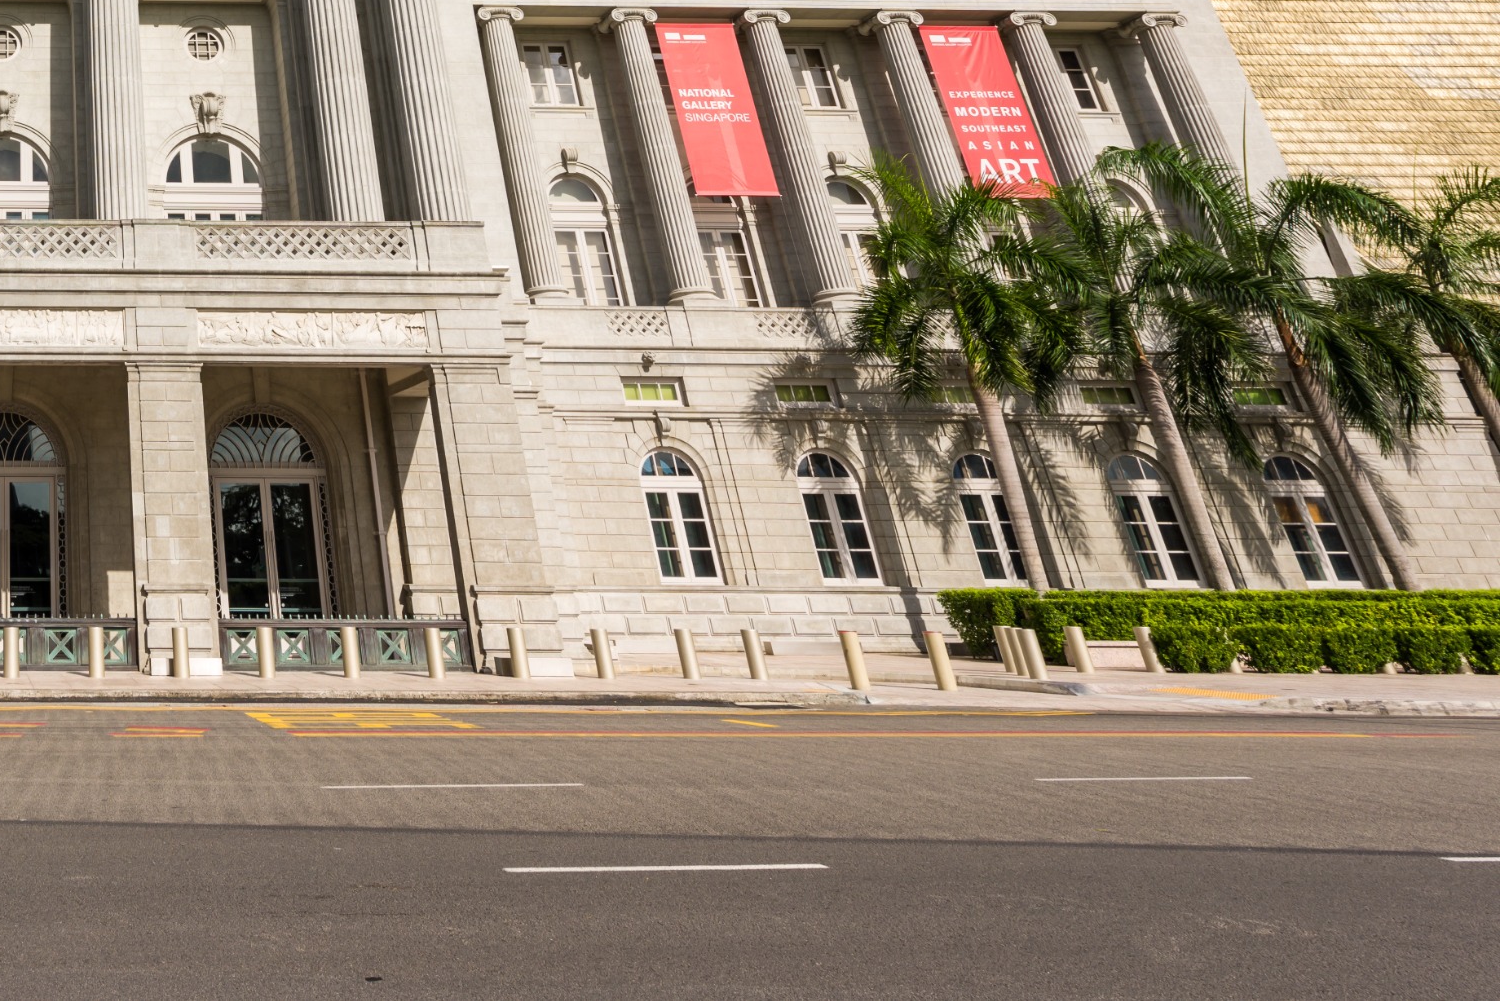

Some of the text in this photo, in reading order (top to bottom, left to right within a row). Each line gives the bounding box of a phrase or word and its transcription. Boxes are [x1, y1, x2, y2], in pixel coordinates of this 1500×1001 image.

[678, 88, 734, 98] NATIONAL
[949, 91, 1015, 99] EXPERIENCE
[682, 101, 732, 109] GALLERY
[955, 106, 1022, 117] MODERN
[685, 113, 751, 122] SINGAPORE
[961, 125, 1027, 133] SOUTHEAST
[980, 158, 1040, 184] ART
